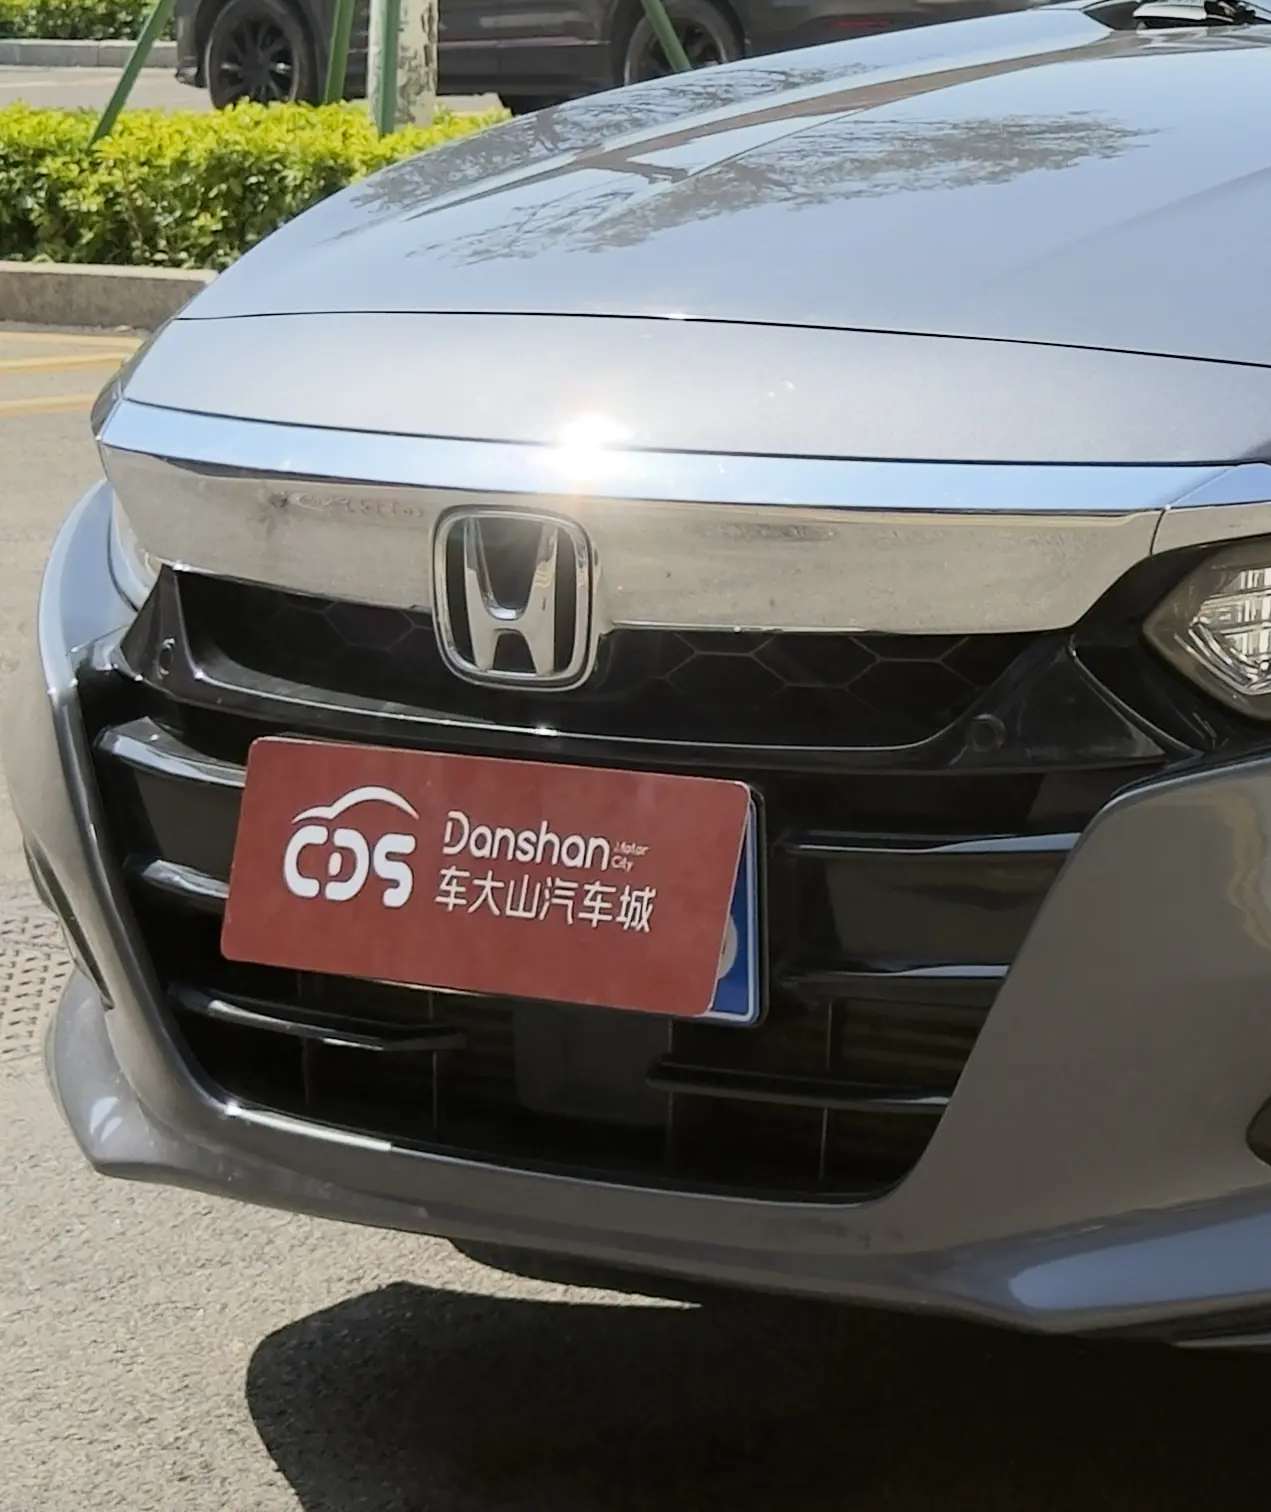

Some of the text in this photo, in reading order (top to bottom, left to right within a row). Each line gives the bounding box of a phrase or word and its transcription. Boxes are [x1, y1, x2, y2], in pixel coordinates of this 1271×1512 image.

[284, 825, 417, 908] CDS
[442, 809, 611, 871] Danshan
[610, 855, 634, 874] City
[434, 865, 658, 934] 车大山汽车城
